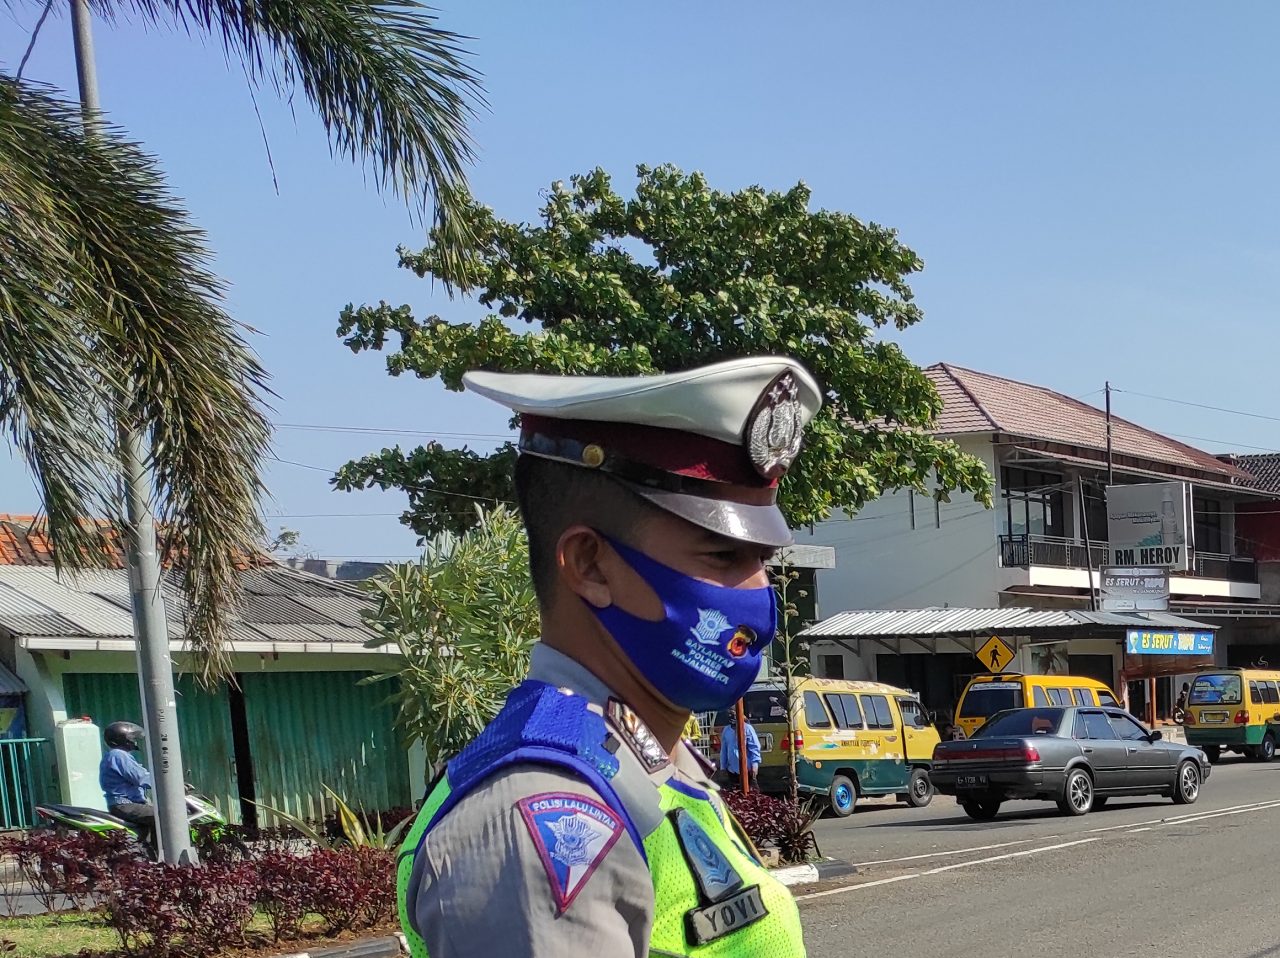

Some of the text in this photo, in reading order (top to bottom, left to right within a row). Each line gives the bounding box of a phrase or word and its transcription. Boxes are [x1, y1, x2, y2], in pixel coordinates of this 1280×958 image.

[1115, 546, 1180, 565] RM. HEROY
[1141, 633, 1150, 649] ES
[1151, 633, 1174, 649] SERUT
[532, 799, 616, 830] POLISI LALU LINTAS
[705, 894, 759, 933] YOVI
